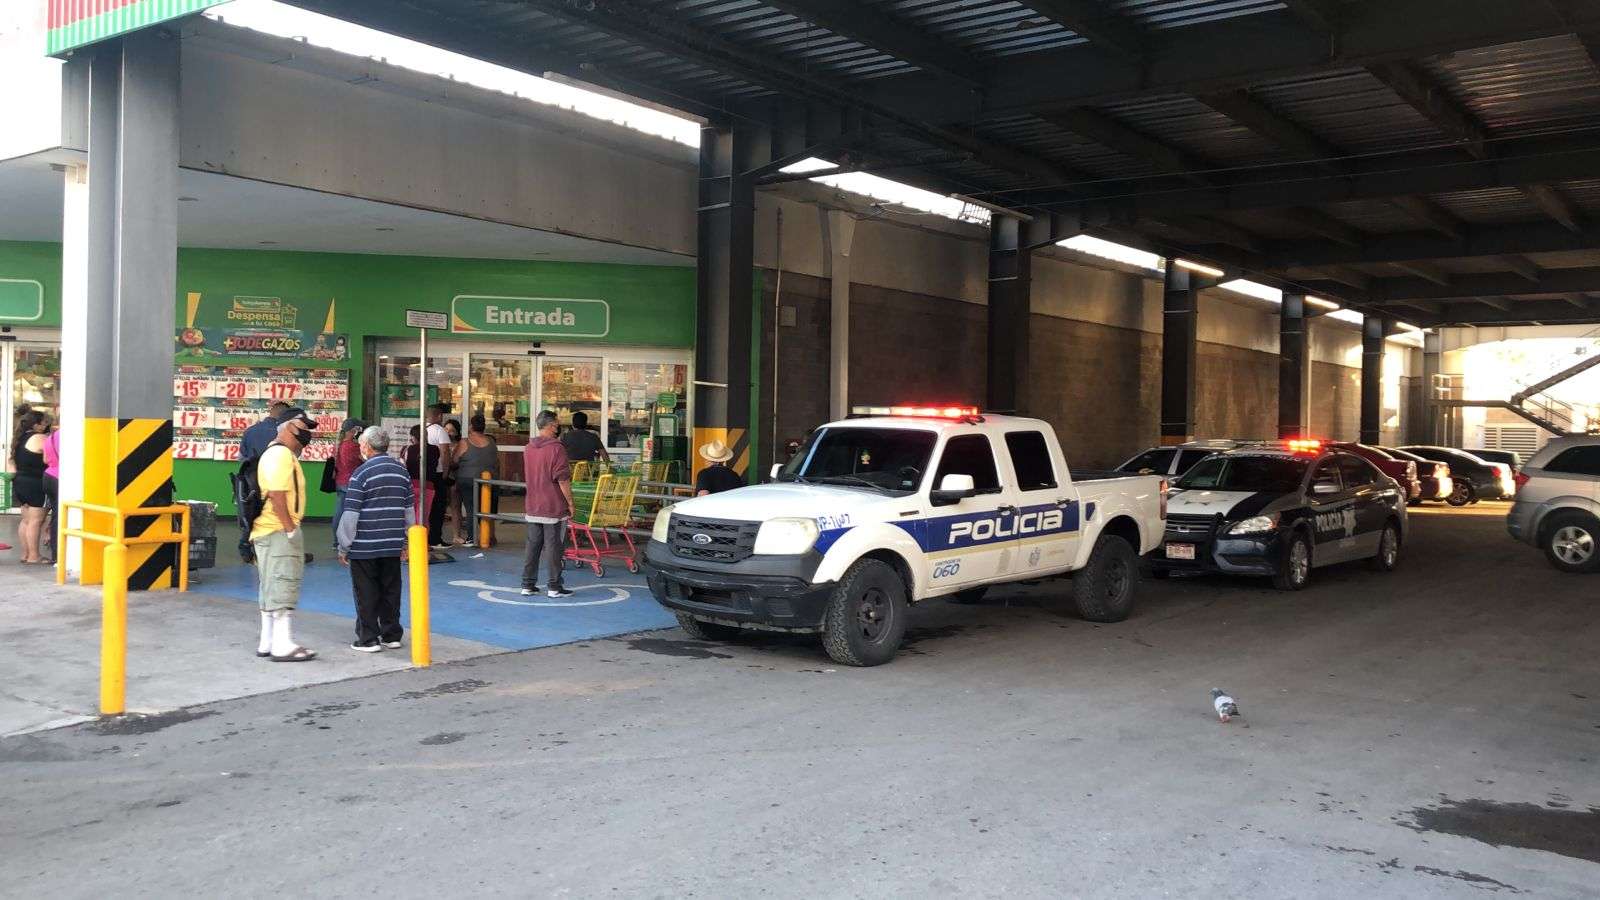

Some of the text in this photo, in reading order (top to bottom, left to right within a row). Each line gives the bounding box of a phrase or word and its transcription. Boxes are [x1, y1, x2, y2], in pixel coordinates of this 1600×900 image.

[227, 310, 281, 321] Despensa
[485, 305, 576, 326] Entrada
[182, 381, 199, 397] 15
[226, 382, 246, 398] 20
[271, 382, 297, 399] 177
[181, 411, 200, 426] 17
[177, 442, 198, 459] 21
[948, 509, 1063, 544] POLICIA
[1315, 511, 1343, 533] POLICIA
[933, 563, 960, 578] 060
